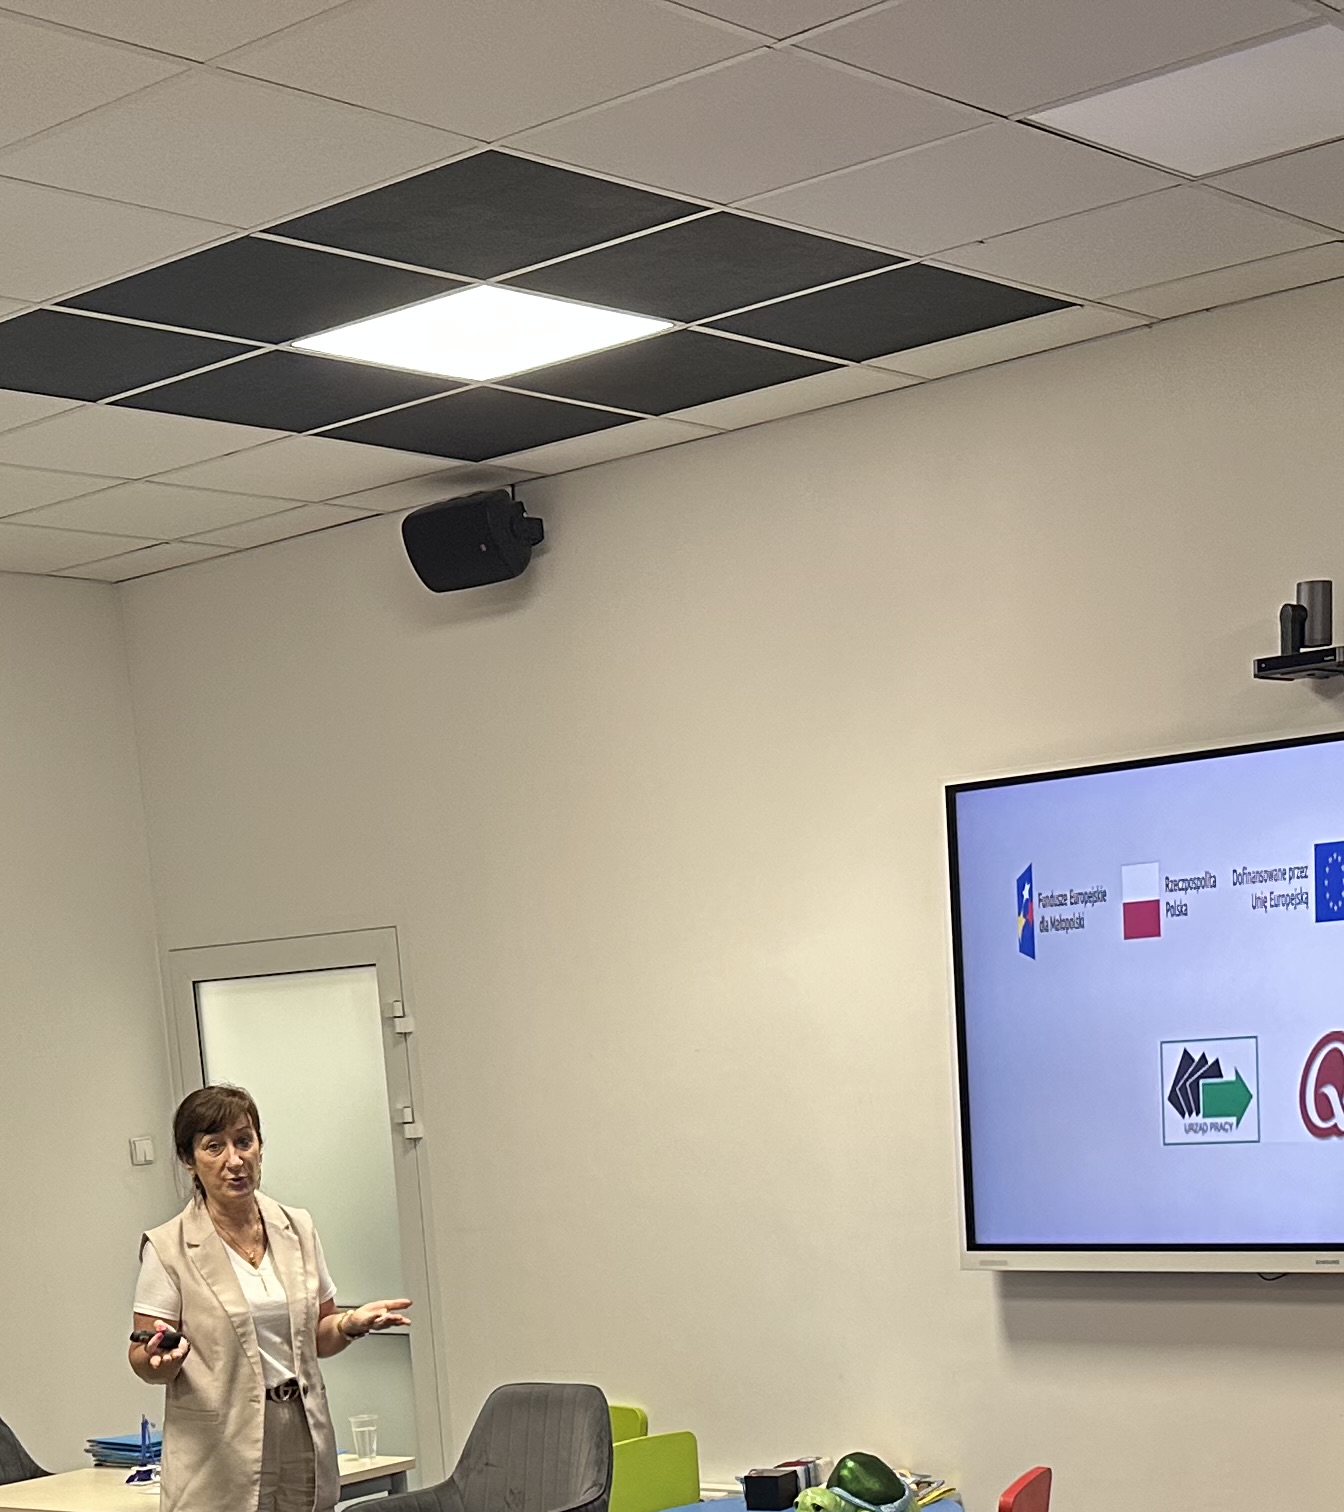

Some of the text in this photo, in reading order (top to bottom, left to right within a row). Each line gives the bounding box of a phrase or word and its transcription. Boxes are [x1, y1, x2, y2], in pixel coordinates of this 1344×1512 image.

[1164, 870, 1217, 895] Rzeczpospolita
[1232, 865, 1309, 887] Dofinansowane przez
[1037, 886, 1108, 911] Fundusze Europejskie
[1165, 901, 1189, 918] Polska
[1251, 887, 1309, 914] Unię Europejską
[1039, 911, 1085, 934] dla Małopolski
[1209, 1120, 1235, 1134] PRACY
